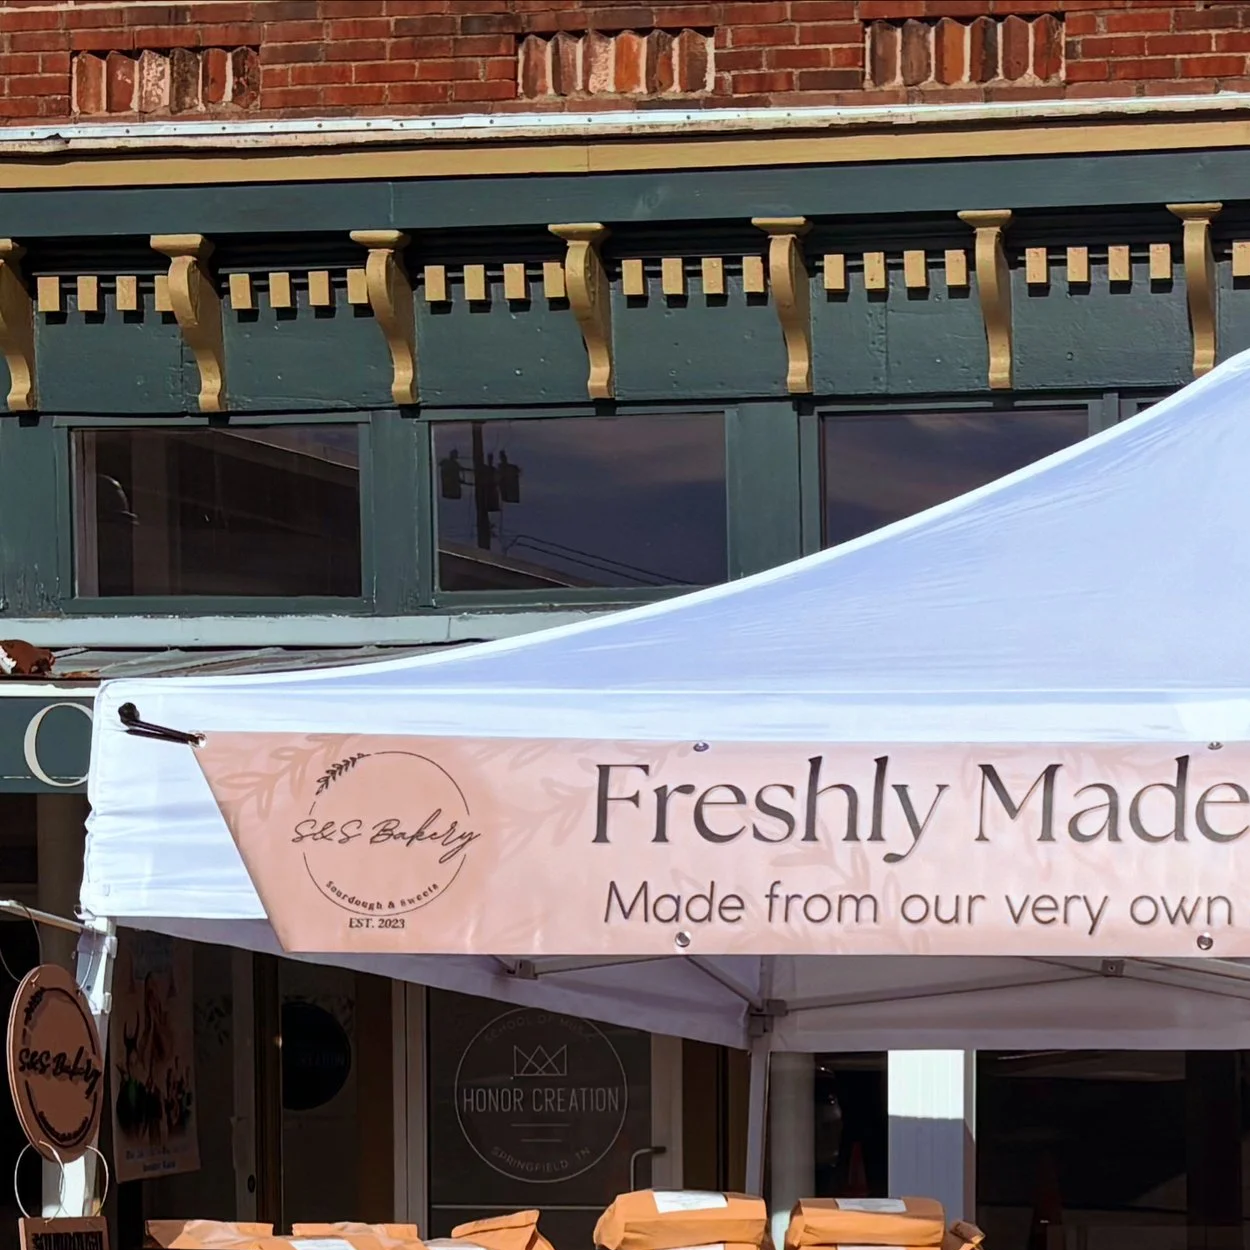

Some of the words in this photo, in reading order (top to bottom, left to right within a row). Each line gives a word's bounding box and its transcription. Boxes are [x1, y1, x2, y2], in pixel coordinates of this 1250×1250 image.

[592, 755, 949, 863] Freshly
[292, 819, 362, 844] S&S
[370, 808, 481, 864] Bakery
[326, 880, 383, 911] Sourdough
[387, 900, 396, 909] &
[400, 883, 439, 907] Sweets
[603, 880, 744, 926] Made
[765, 880, 892, 926] from
[901, 891, 985, 926] our
[1005, 891, 1109, 936] very
[1130, 891, 1232, 926] own
[349, 918, 374, 929] EST.
[378, 918, 405, 929] 2023
[463, 1087, 524, 1113] HONOR
[532, 1087, 619, 1113] CREATION
[490, 1145, 569, 1174] SPRINGFIELD
